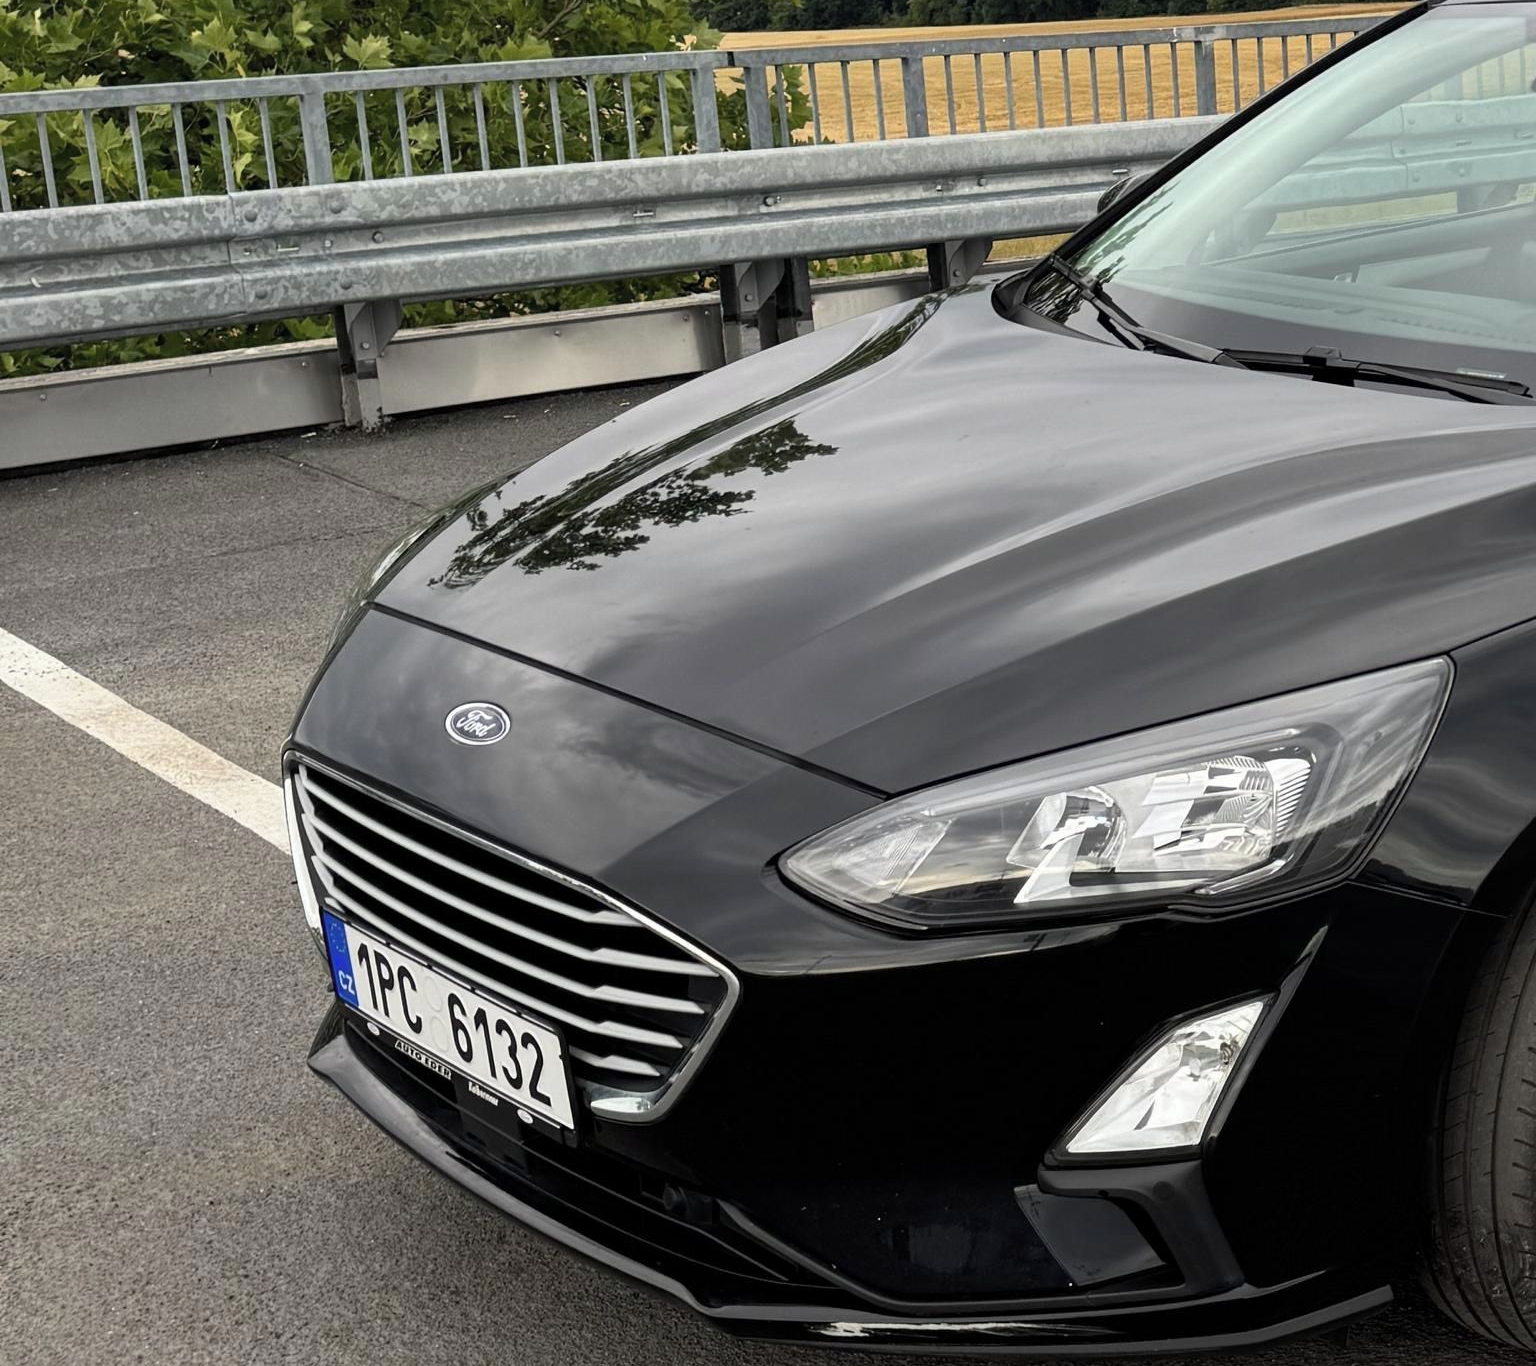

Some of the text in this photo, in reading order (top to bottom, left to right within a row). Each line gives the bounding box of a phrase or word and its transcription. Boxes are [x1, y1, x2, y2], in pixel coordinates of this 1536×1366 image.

[456, 710, 496, 737] Ford
[338, 969, 356, 996] CZ
[357, 943, 552, 1108] 1PC 6132
[395, 1039, 452, 1080] AUTO EDER
